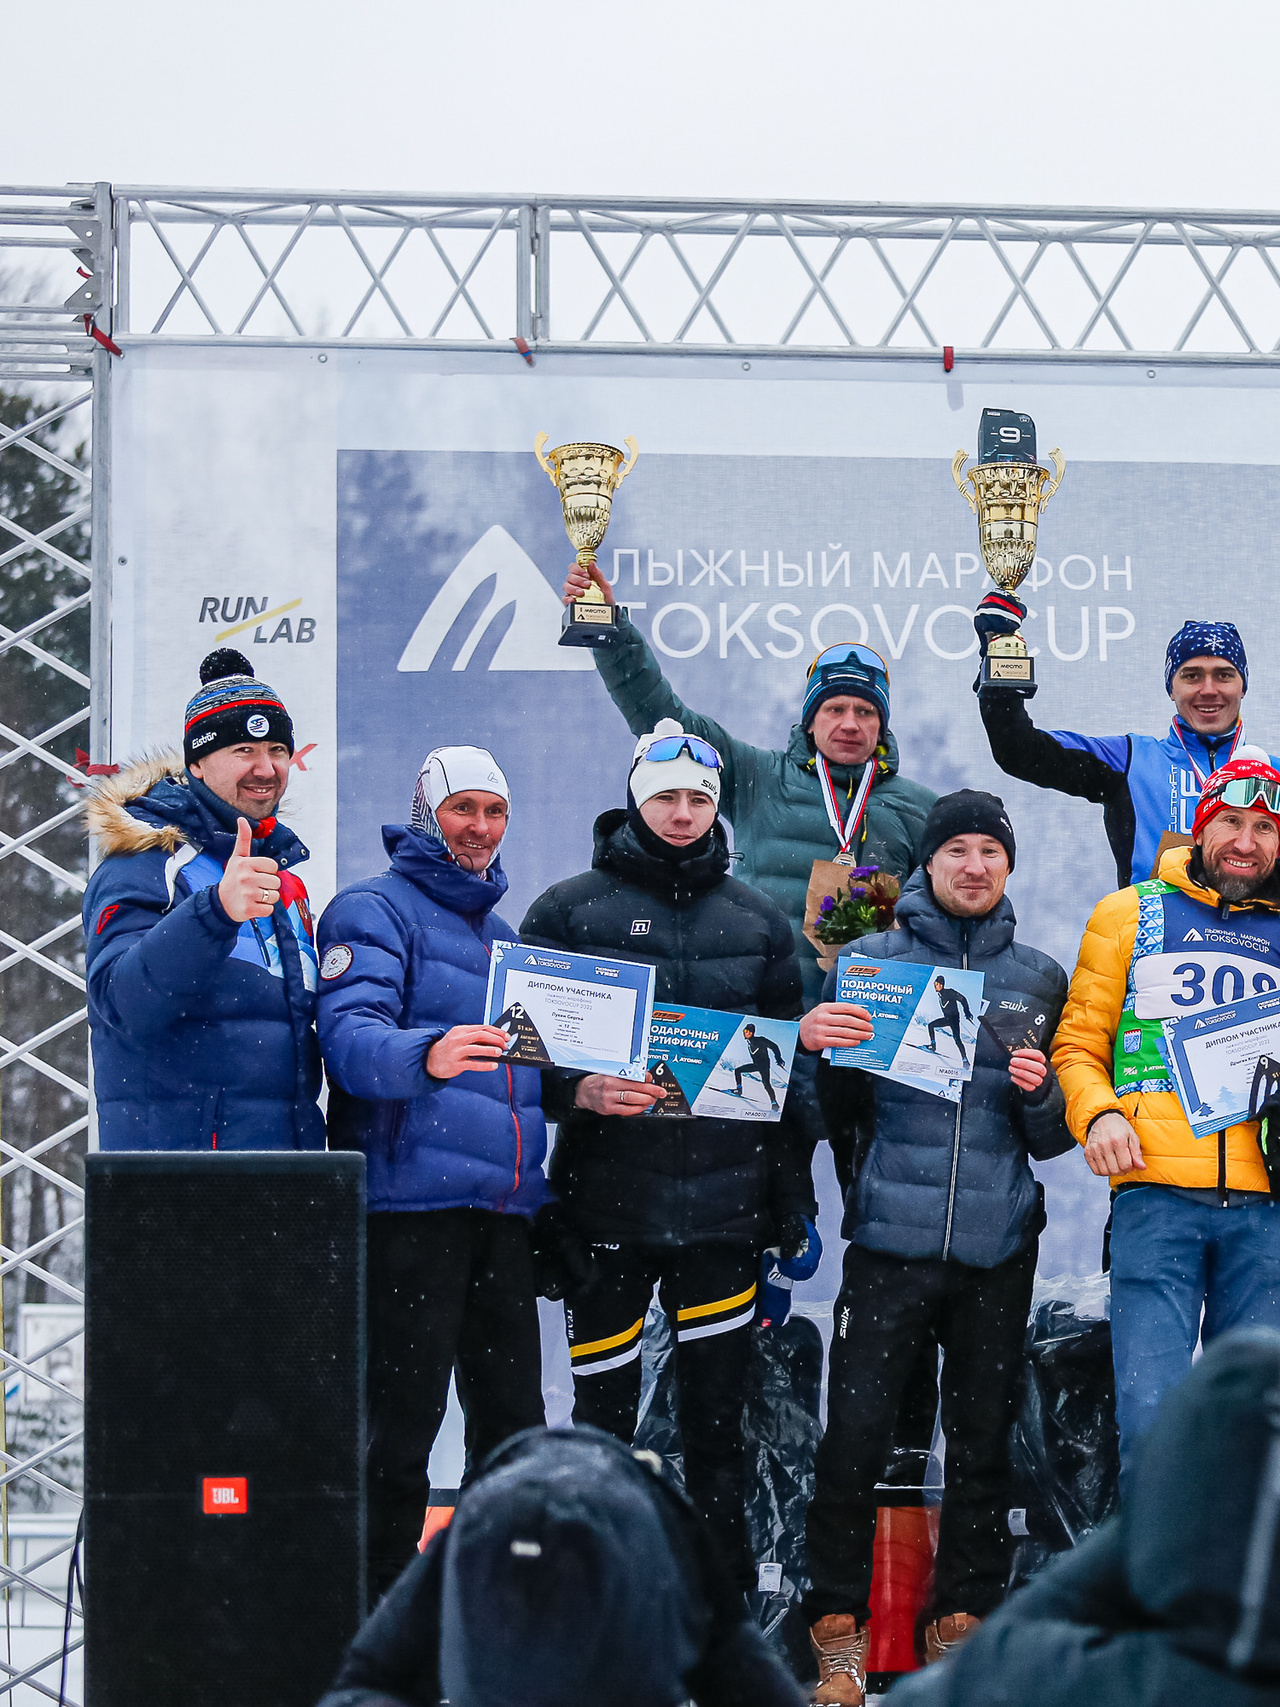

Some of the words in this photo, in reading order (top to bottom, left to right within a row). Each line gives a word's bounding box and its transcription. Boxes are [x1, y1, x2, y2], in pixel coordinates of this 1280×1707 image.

[609, 542, 850, 587] ЛЫЖНЫЙ
[873, 551, 1132, 592] МАРФОН
[199, 597, 268, 623] RUN
[254, 618, 316, 643] LAB
[1204, 934, 1270, 954] TOKSOVOCUP
[527, 980, 564, 993] ДИПЛОМ
[566, 986, 612, 1000] УЧАСТНИКА
[841, 980, 913, 995] ПОДАРОЧНЫЙ
[840, 990, 902, 1004] СЕРТИФИКАТ
[510, 1006, 524, 1019] 12
[1034, 1014, 1046, 1026] 8
[651, 1025, 719, 1041] ОДАРОЧНЫЙ
[648, 1035, 708, 1050] ЕРТИФИКАТ
[1205, 1034, 1239, 1049] ДИПЛОМ
[656, 1063, 664, 1075] 6
[1260, 1057, 1269, 1069] 9
[212, 1487, 239, 1504] JBL
